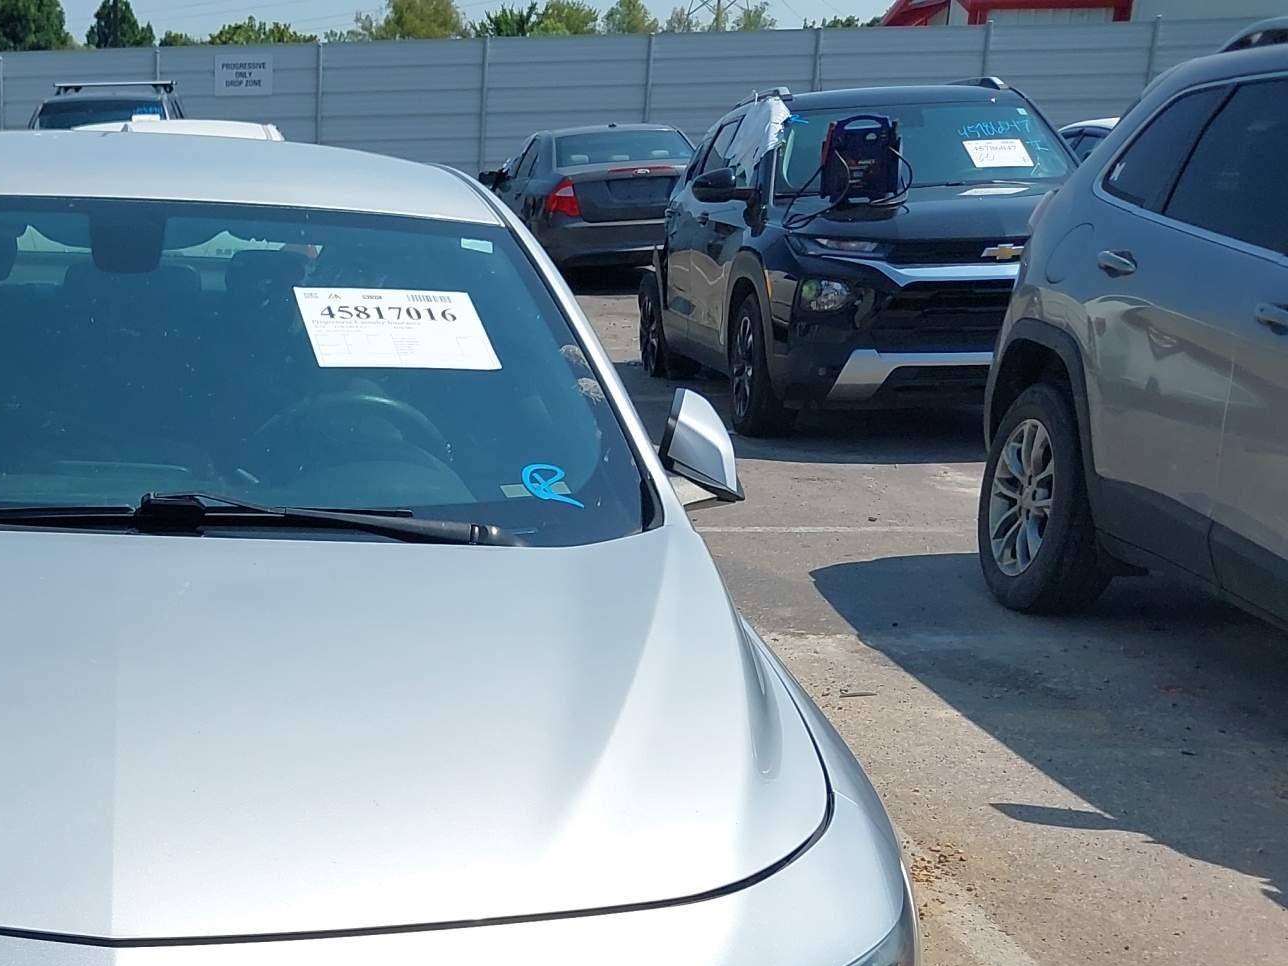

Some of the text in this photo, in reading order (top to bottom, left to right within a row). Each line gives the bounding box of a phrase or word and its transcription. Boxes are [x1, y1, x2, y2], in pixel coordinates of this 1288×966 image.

[221, 62, 266, 70] PROGRESSIVE
[234, 71, 253, 79] ONLY
[225, 79, 262, 88] DROP ZONE
[319, 305, 458, 323] 45817016
